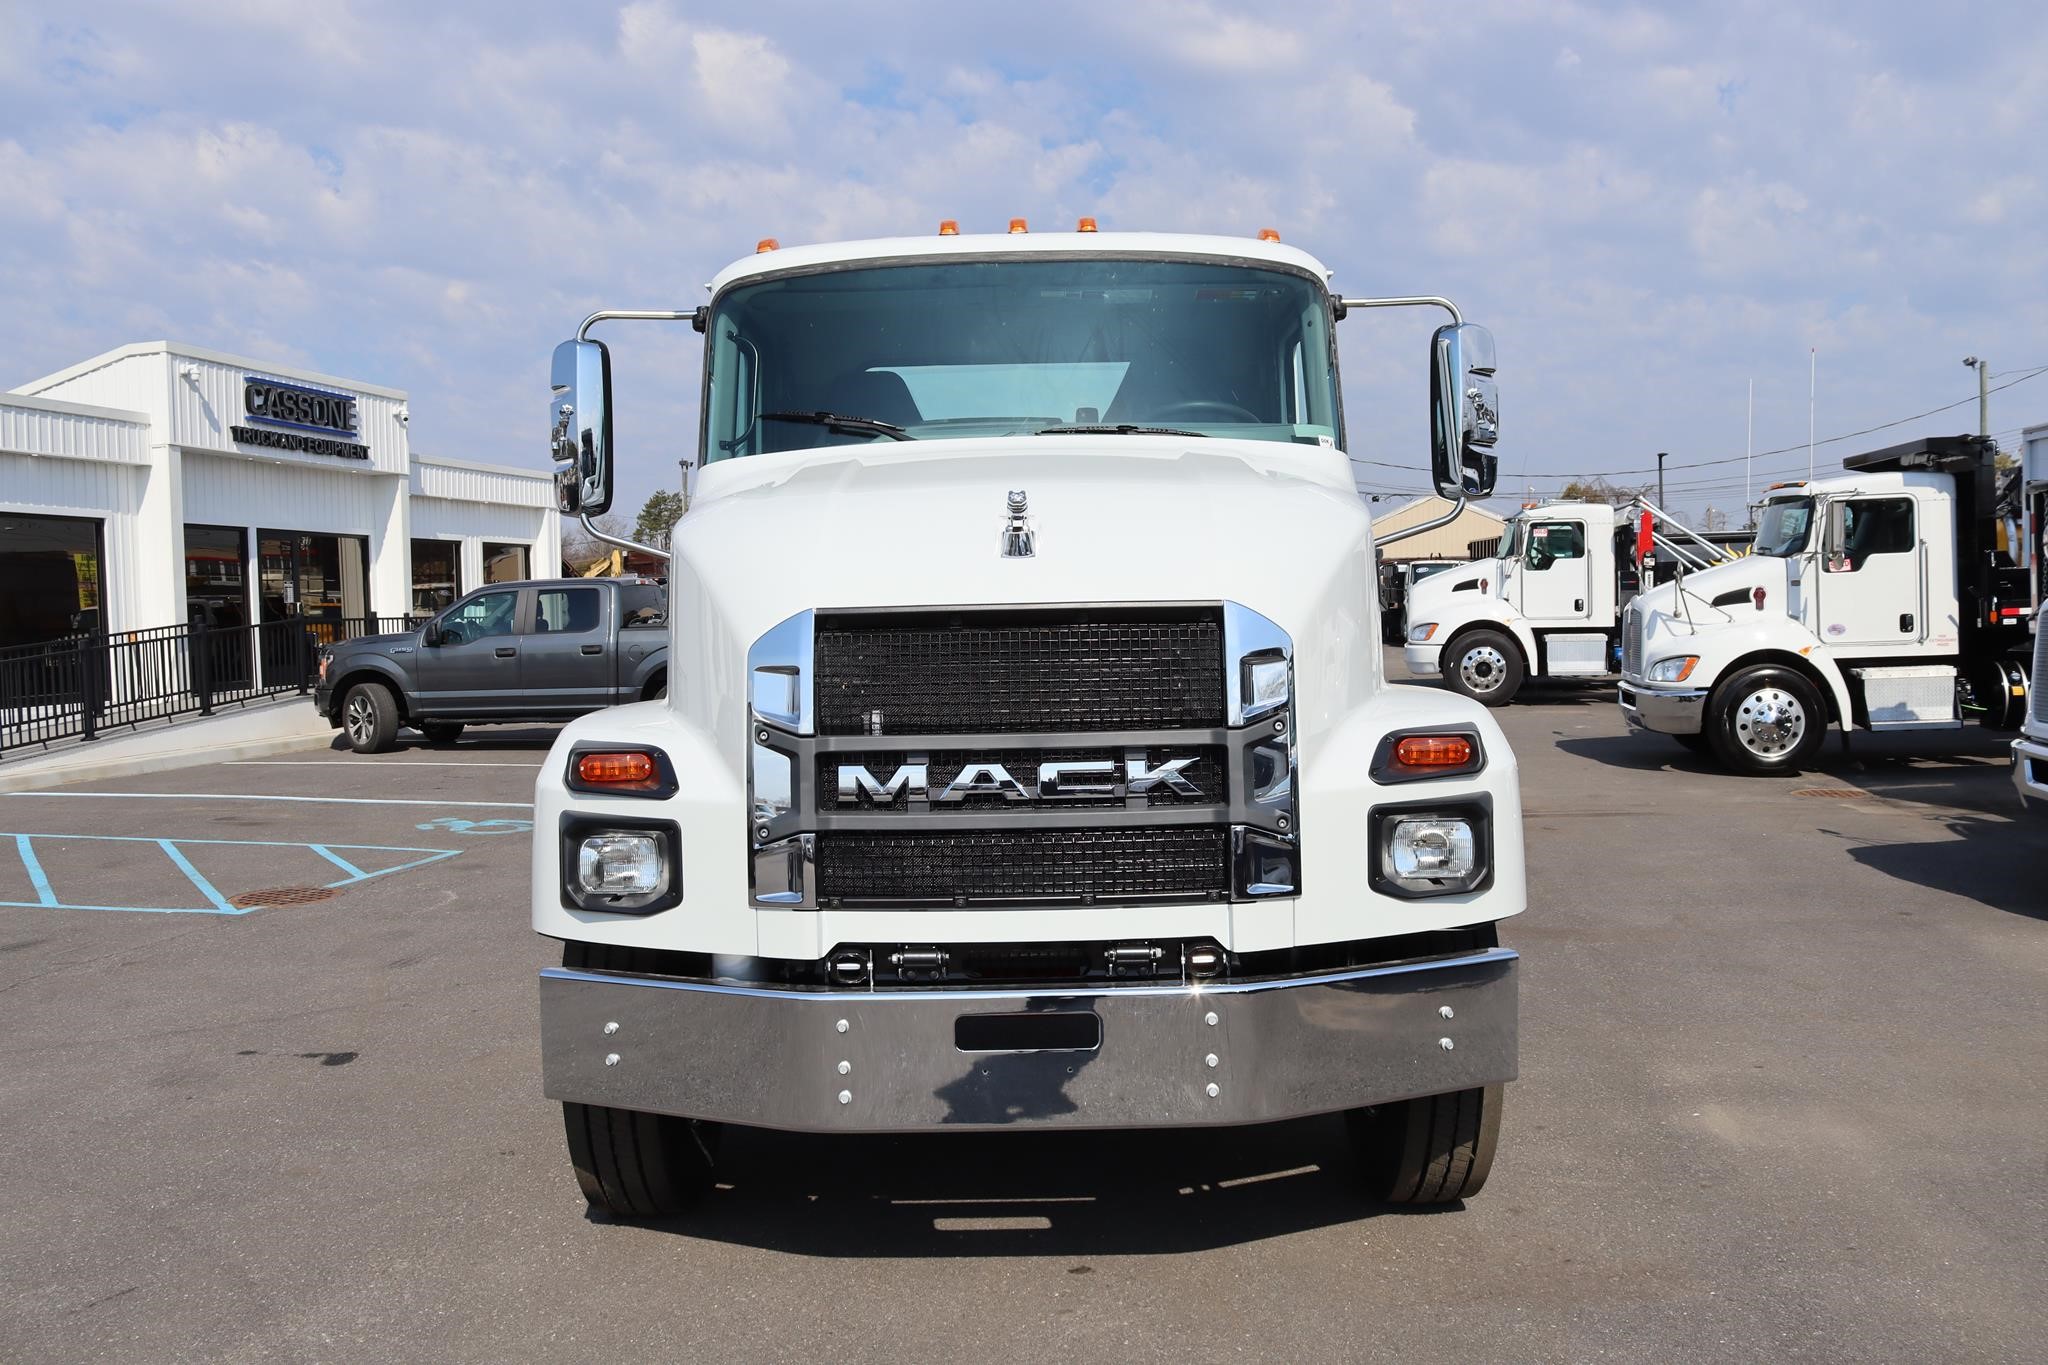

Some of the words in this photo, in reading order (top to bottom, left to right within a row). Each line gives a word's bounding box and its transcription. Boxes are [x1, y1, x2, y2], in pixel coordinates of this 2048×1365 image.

[245, 384, 357, 431] CASSONE
[230, 426, 278, 447] TRUCK
[279, 433, 304, 450] AND
[307, 438, 370, 459] EQUIPMENT
[838, 757, 1204, 801] MACK
